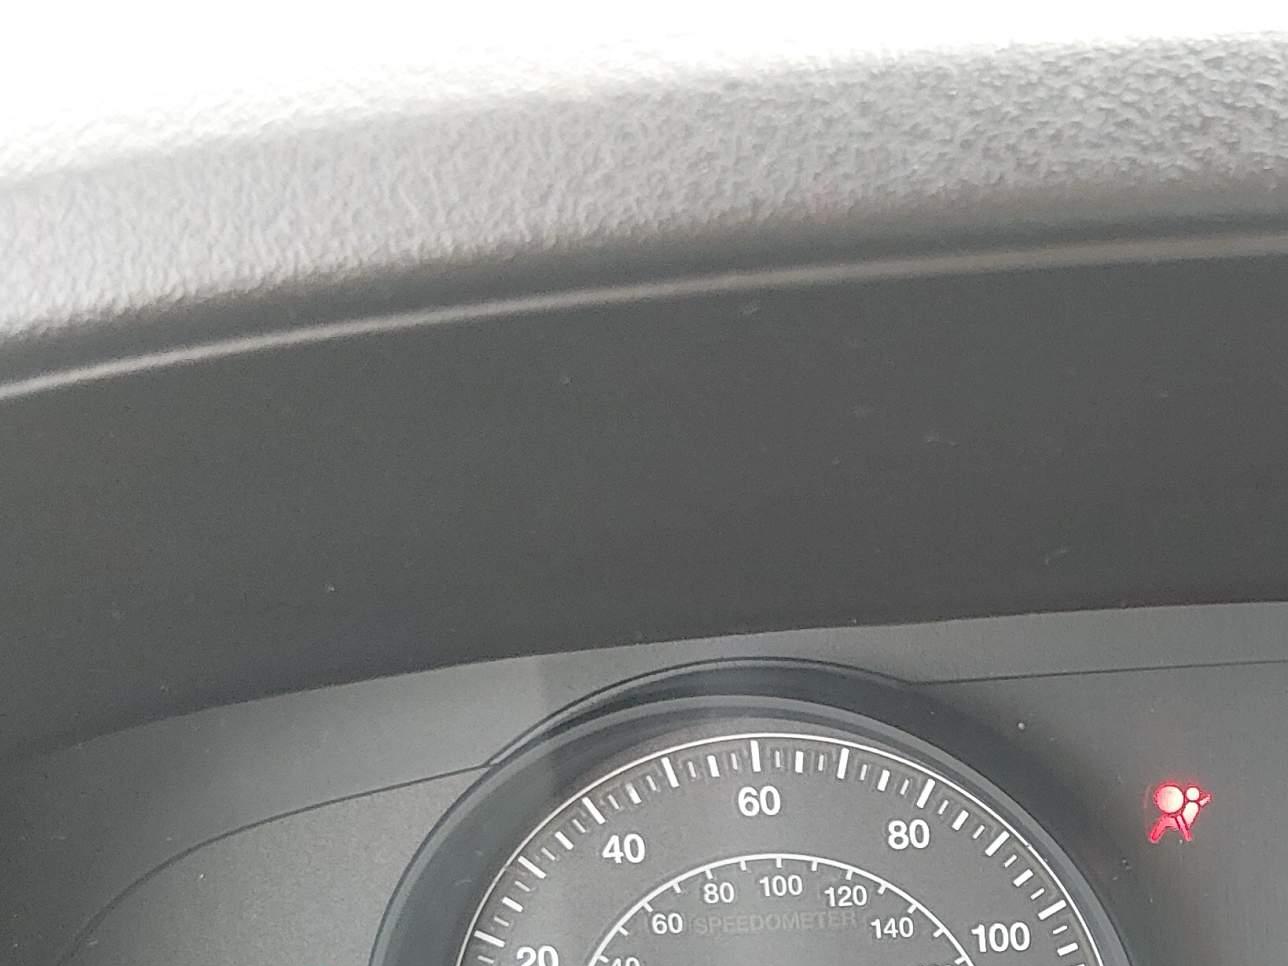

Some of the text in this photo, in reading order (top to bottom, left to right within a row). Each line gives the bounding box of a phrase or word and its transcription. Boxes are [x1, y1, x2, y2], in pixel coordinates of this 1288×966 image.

[737, 785, 781, 817] 60
[887, 818, 930, 850] 80
[601, 833, 646, 864] 40
[703, 881, 735, 904] 80
[759, 874, 803, 897] 100
[823, 884, 868, 907] 120
[651, 912, 683, 935] 60
[694, 910, 858, 936] SPEEDOMETER
[870, 916, 914, 939] 140
[970, 921, 1030, 953] 100
